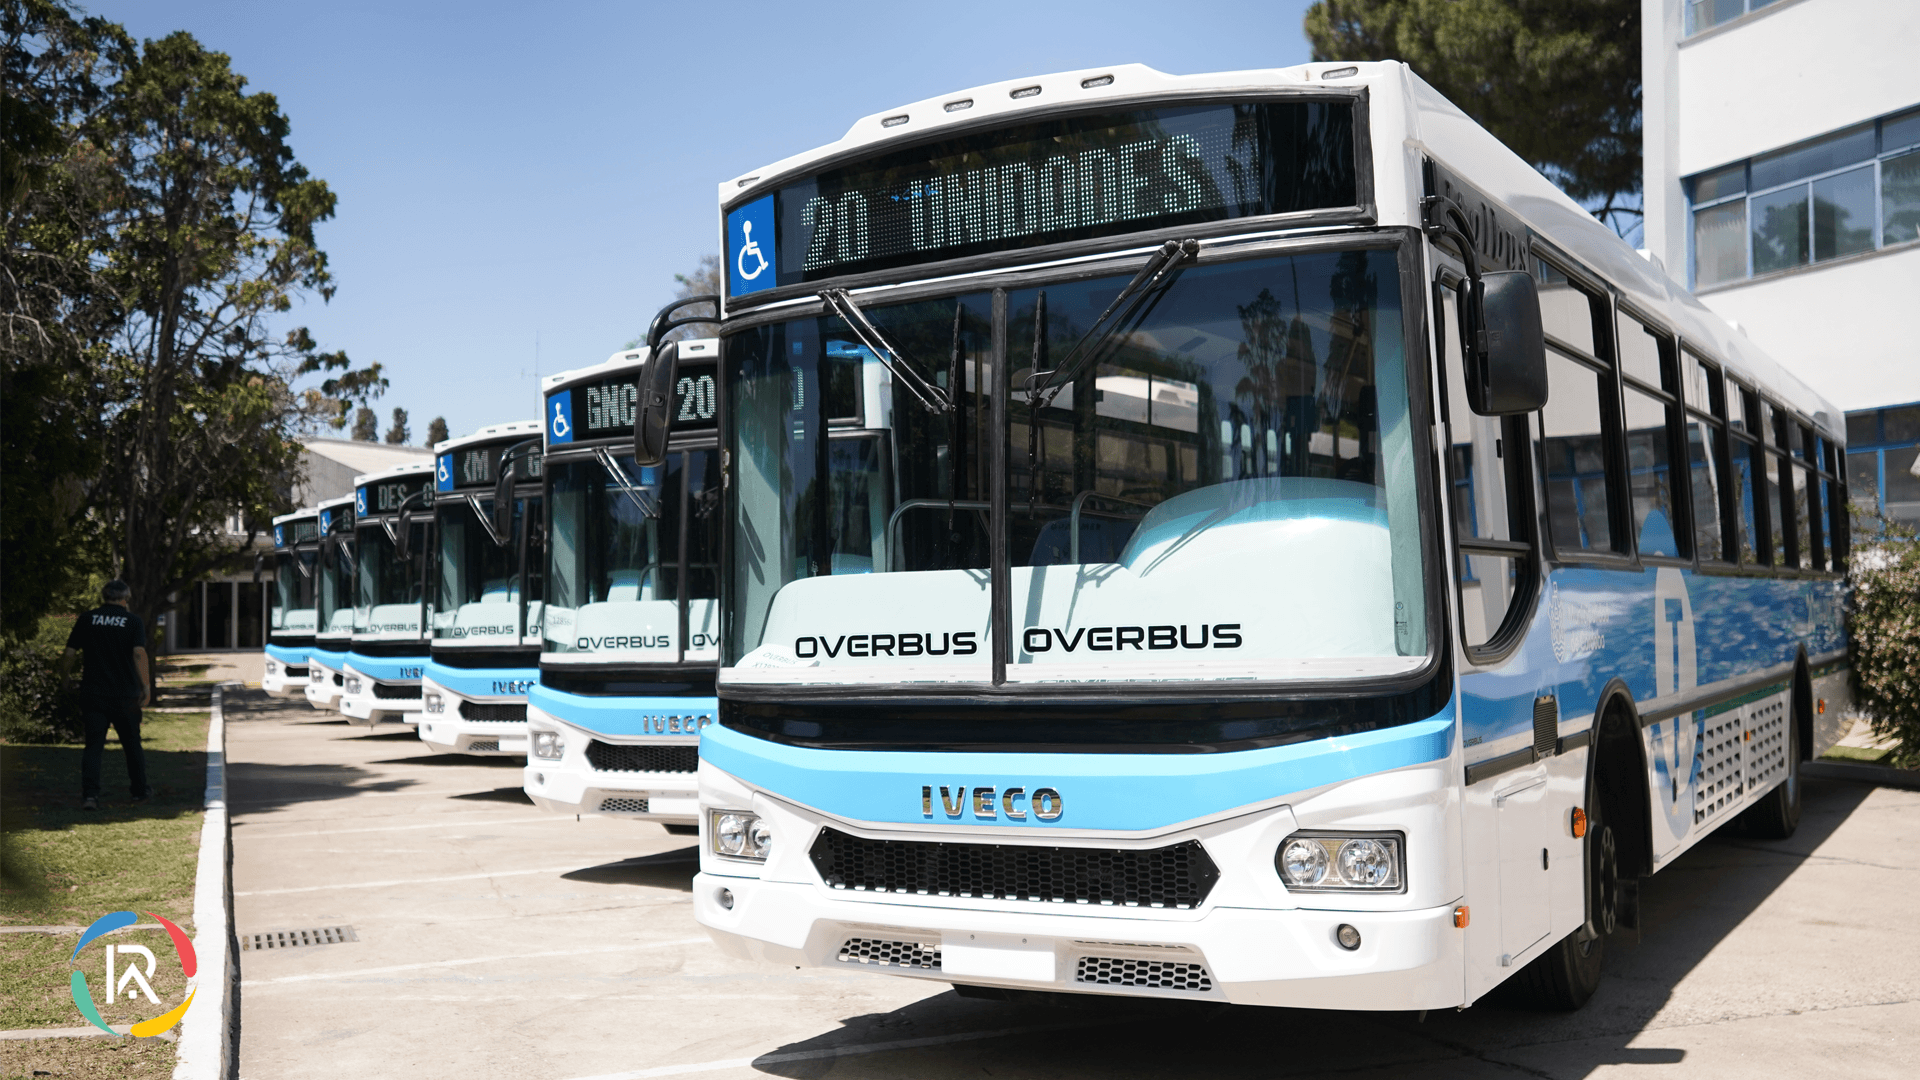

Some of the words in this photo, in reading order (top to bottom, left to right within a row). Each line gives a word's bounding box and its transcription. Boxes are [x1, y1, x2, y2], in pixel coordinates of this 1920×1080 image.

[800, 191, 868, 271] 20
[911, 134, 1202, 251] UNIDADES
[677, 376, 716, 421] 20
[92, 615, 128, 628] TAMSE
[370, 623, 418, 633] OVERBUS
[454, 625, 514, 636] OVERBUS
[577, 635, 670, 649] OVERBUS
[795, 632, 978, 659] OVERBUS
[1023, 624, 1243, 652] OVERBUS
[921, 785, 1064, 820] IVECO
